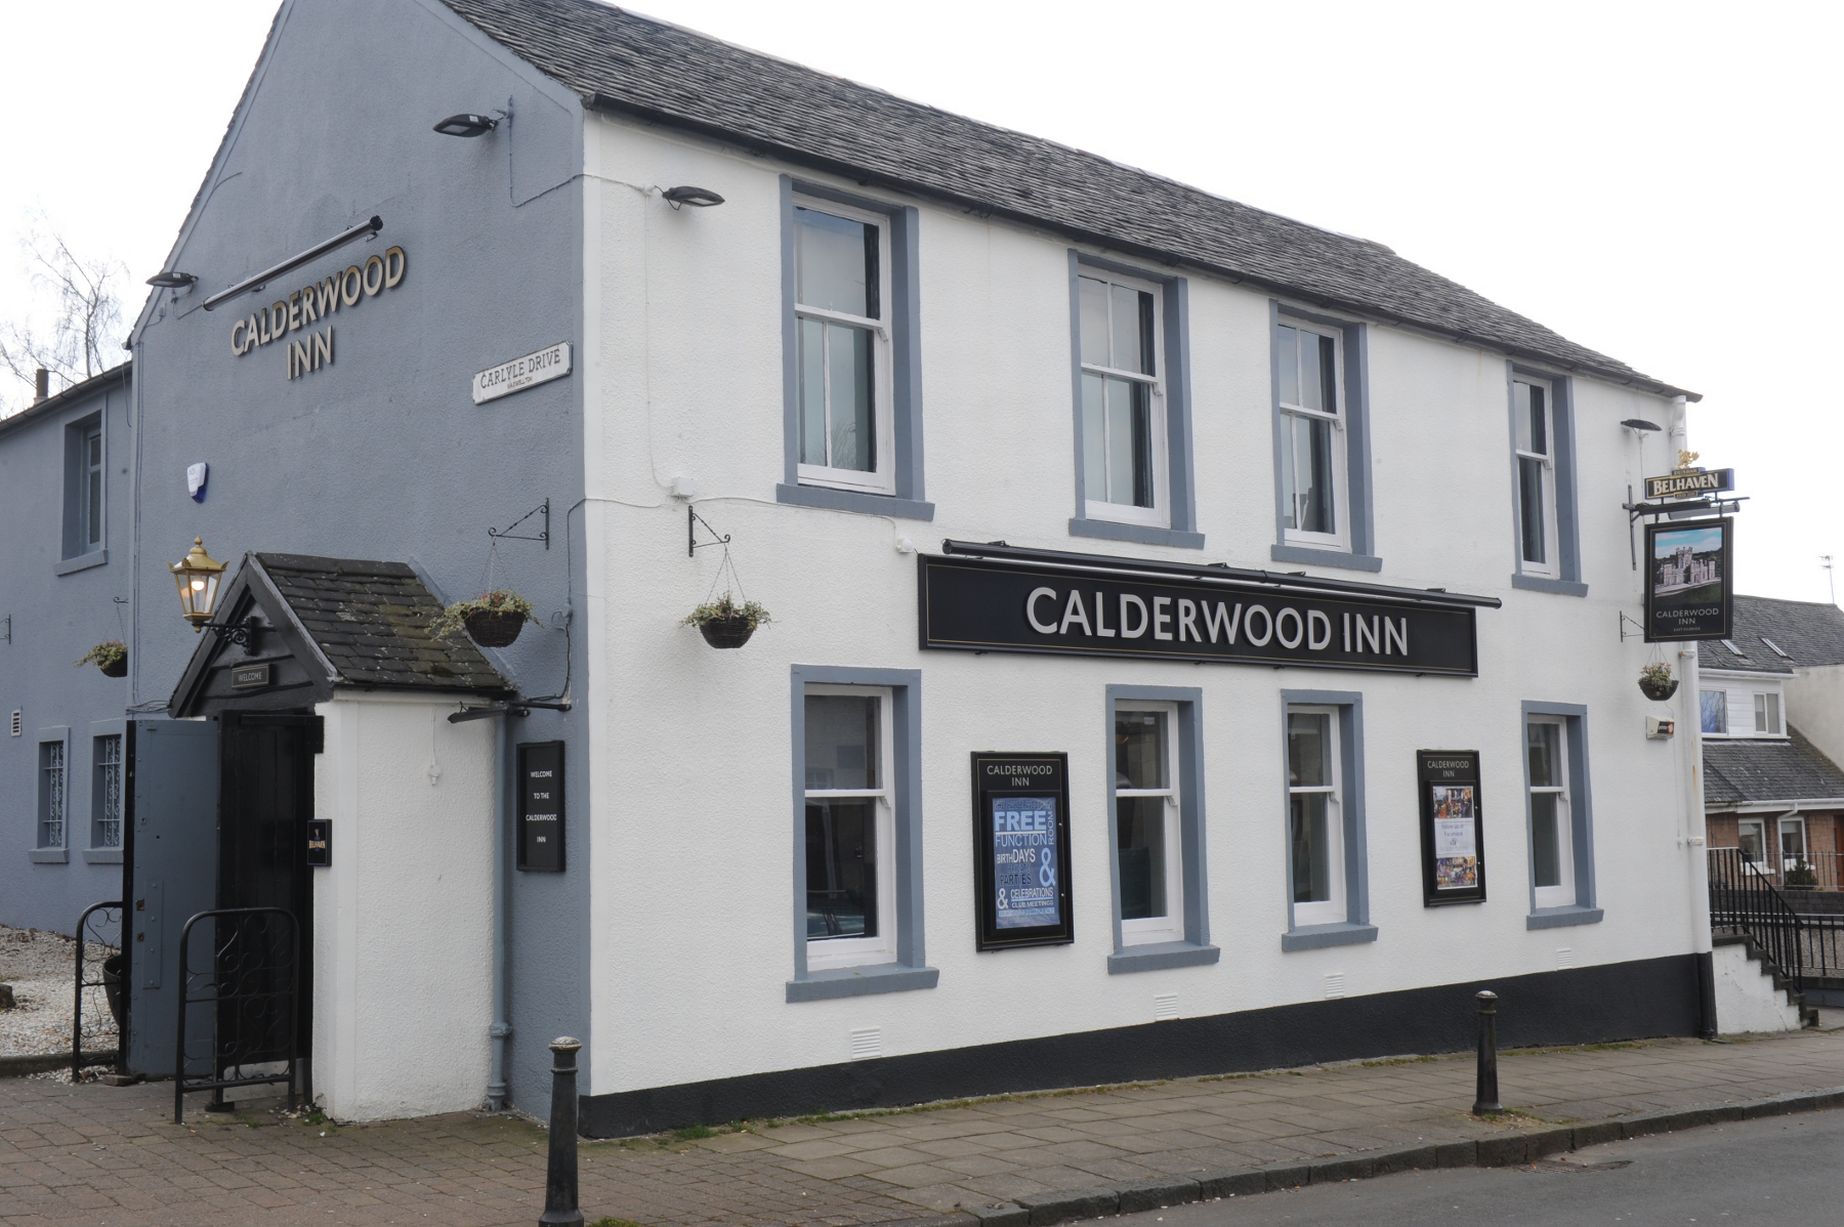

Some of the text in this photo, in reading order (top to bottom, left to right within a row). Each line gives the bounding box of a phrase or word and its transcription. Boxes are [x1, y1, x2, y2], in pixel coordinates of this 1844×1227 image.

[231, 245, 406, 357] CALDERWOOD
[287, 325, 334, 380] INN
[481, 348, 561, 389] CARLYLE DRIVE
[1653, 472, 1719, 496] BELHAVEN
[1656, 607, 1719, 619] CALDERWOOD
[1026, 586, 1409, 656] CALDERWOOD INN
[1678, 617, 1696, 625] INN
[239, 671, 264, 682] WELCOME
[986, 765, 1053, 775] CALDERWOOD
[1427, 760, 1470, 769] CALDERWOOD
[530, 770, 552, 778] WELCOME
[1442, 769, 1455, 777] INN
[1011, 777, 1030, 787] INN
[533, 792, 540, 800] TO
[994, 810, 1047, 831] FREE
[1047, 810, 1055, 845] ROOM
[995, 832, 1047, 847] FUNCTION
[1010, 886, 1054, 899] CELEBRATIONS
